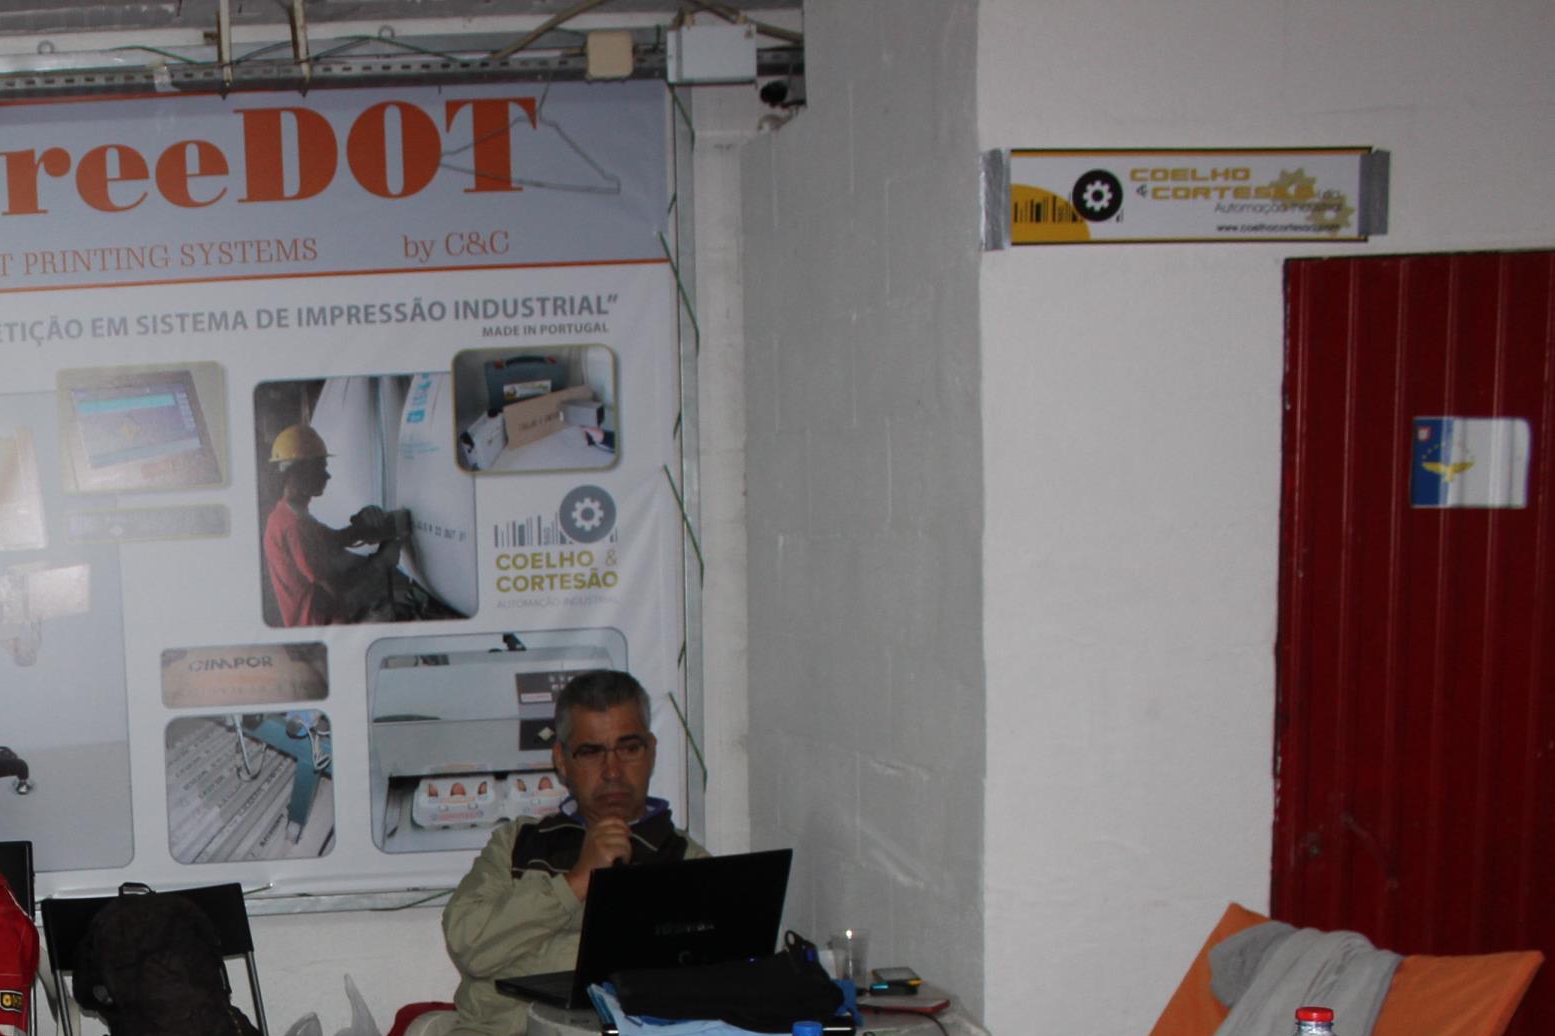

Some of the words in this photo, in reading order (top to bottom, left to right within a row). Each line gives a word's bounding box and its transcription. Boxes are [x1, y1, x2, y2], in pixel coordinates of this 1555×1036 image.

[1129, 167, 1251, 182] COELHO
[22, 244, 171, 277] PRINTING
[179, 236, 319, 267] SYSTEMS
[401, 233, 437, 263] by
[445, 229, 511, 257] C&C
[91, 315, 130, 339] EM
[136, 309, 248, 336] SISTEMA
[256, 307, 290, 330] DE
[297, 296, 446, 327] IMPRESSÃO
[482, 324, 520, 338] MADE
[522, 324, 537, 336] IN
[540, 321, 609, 336] PORTUGAL
[496, 550, 594, 571] COELHO
[605, 548, 619, 568] &
[496, 567, 619, 593] CORTESÃO
[188, 654, 274, 673] CIMPOR
